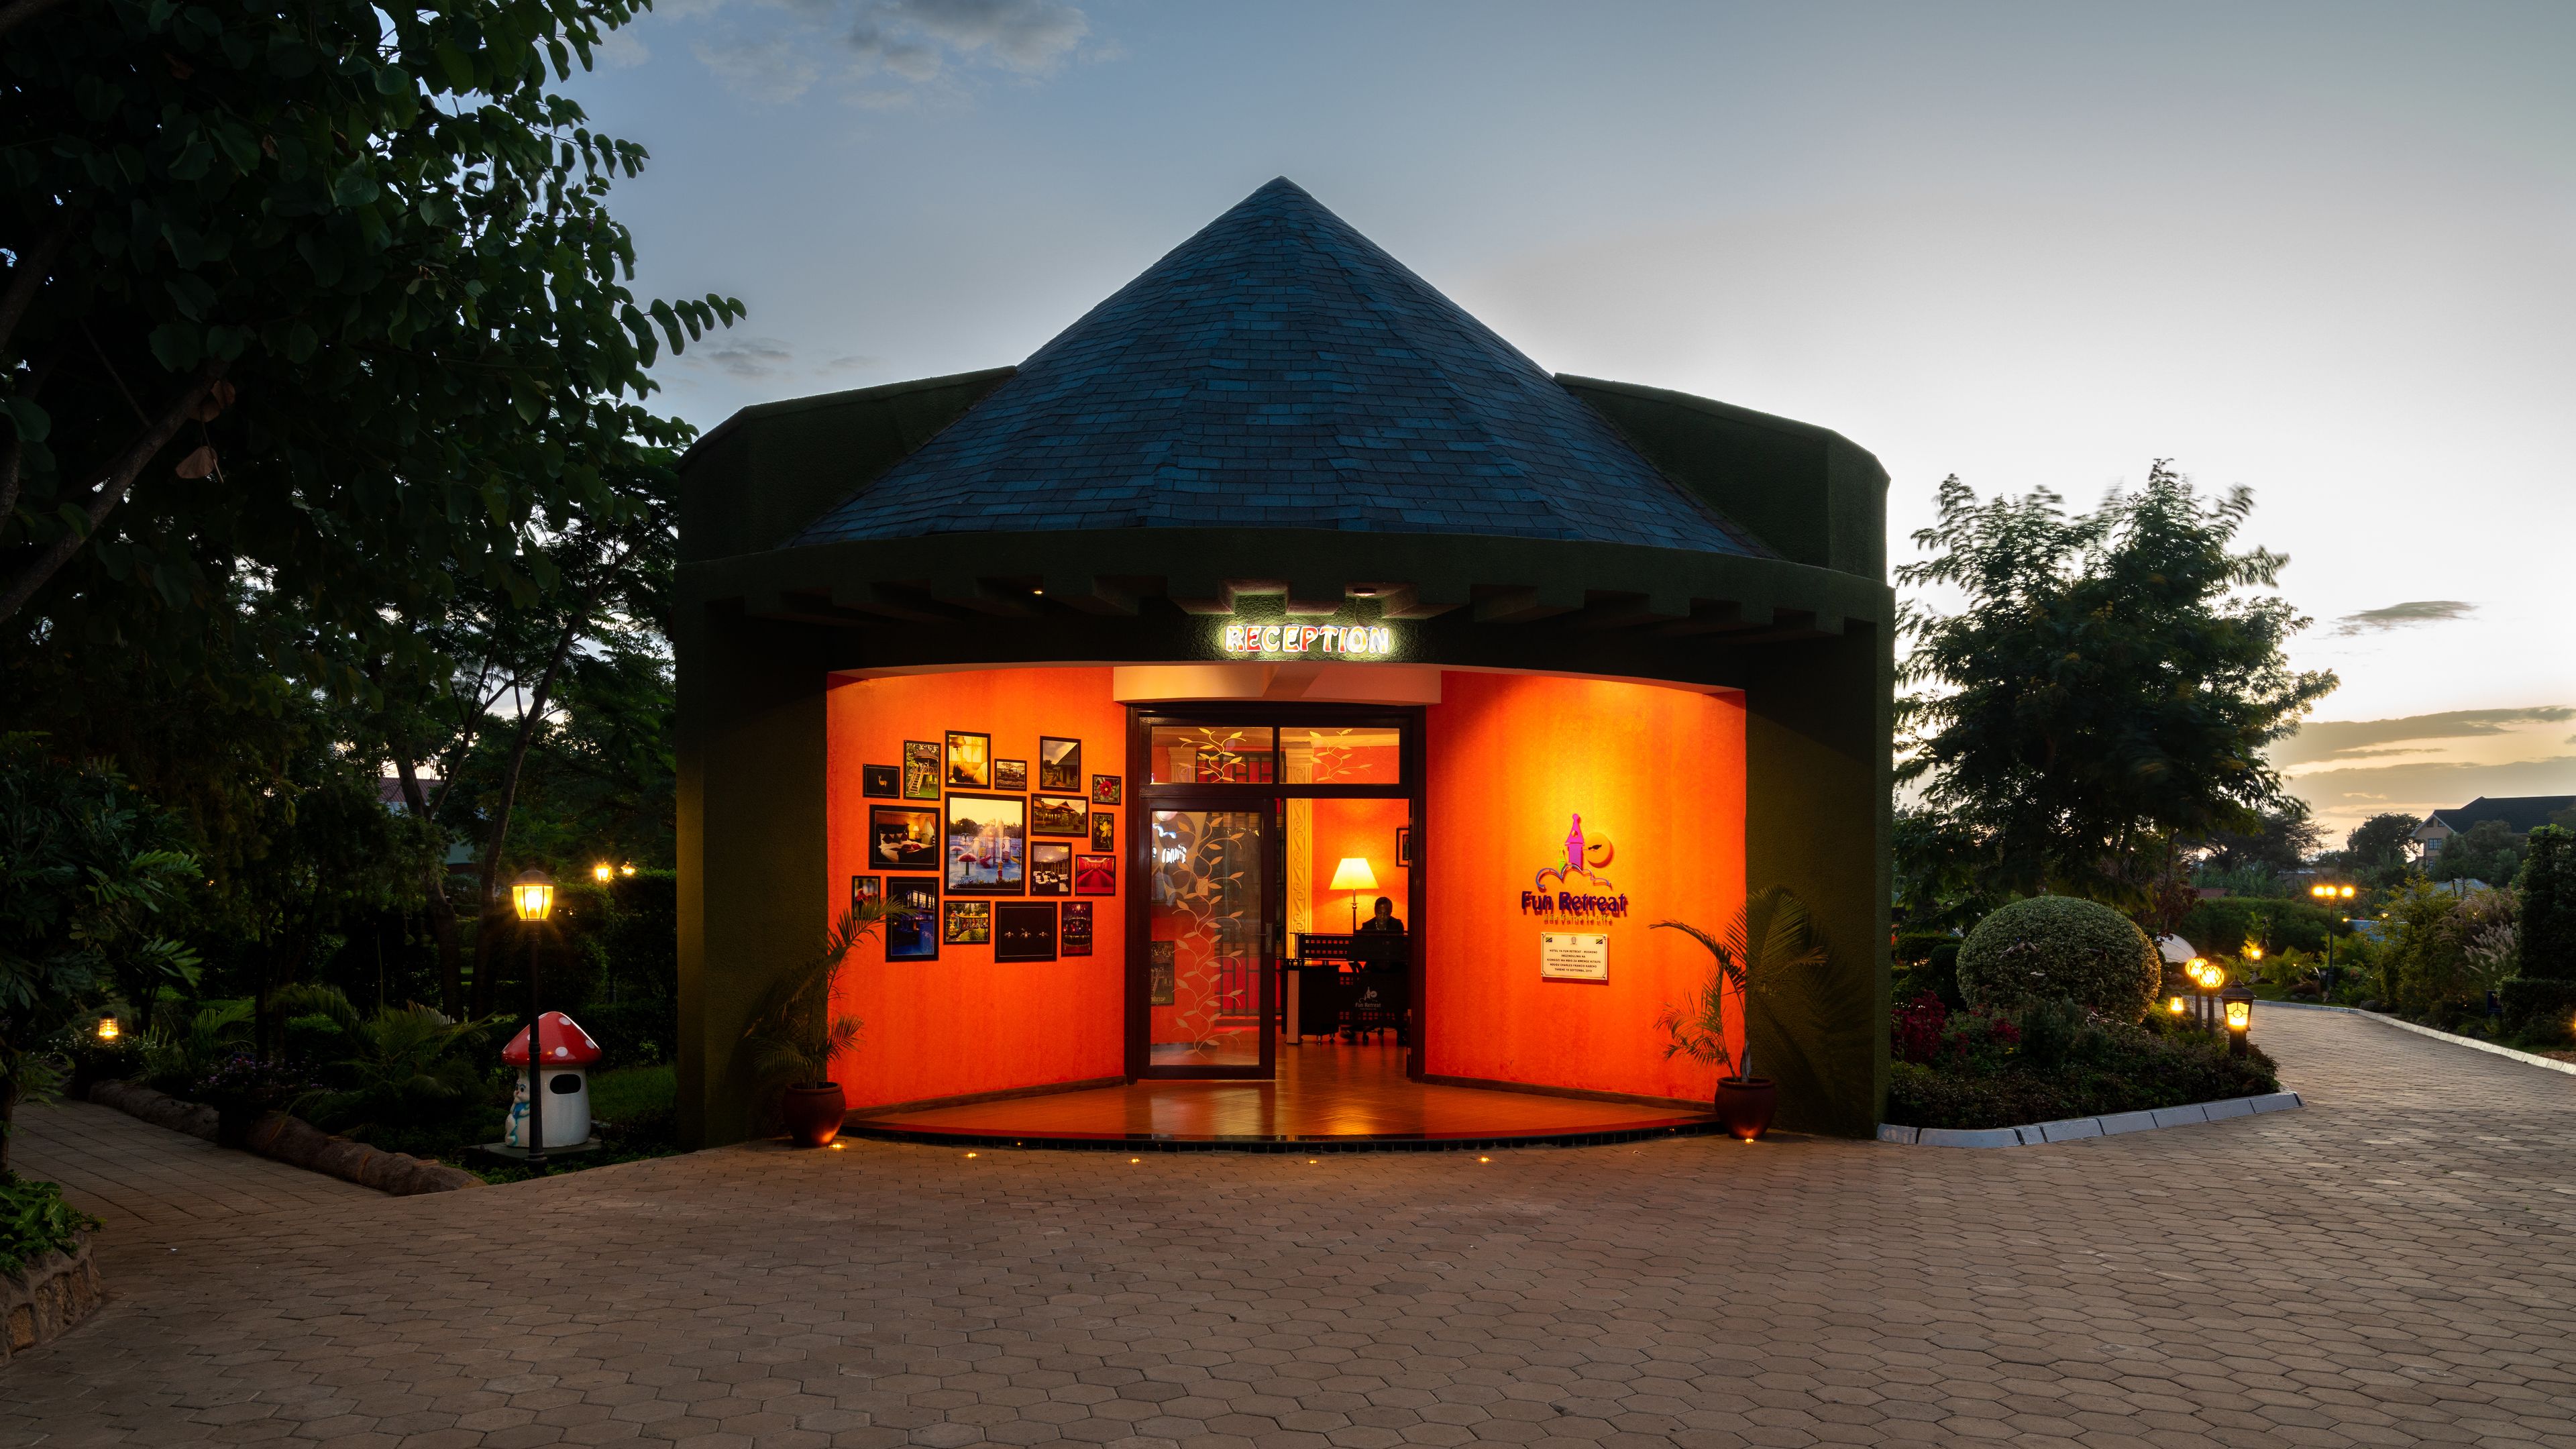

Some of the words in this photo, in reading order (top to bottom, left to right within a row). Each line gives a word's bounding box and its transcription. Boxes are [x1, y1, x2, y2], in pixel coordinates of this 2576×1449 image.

[1226, 625, 1389, 653] RECEPTION
[1521, 891, 1552, 910] Fun
[1559, 892, 1627, 911] Retreat
